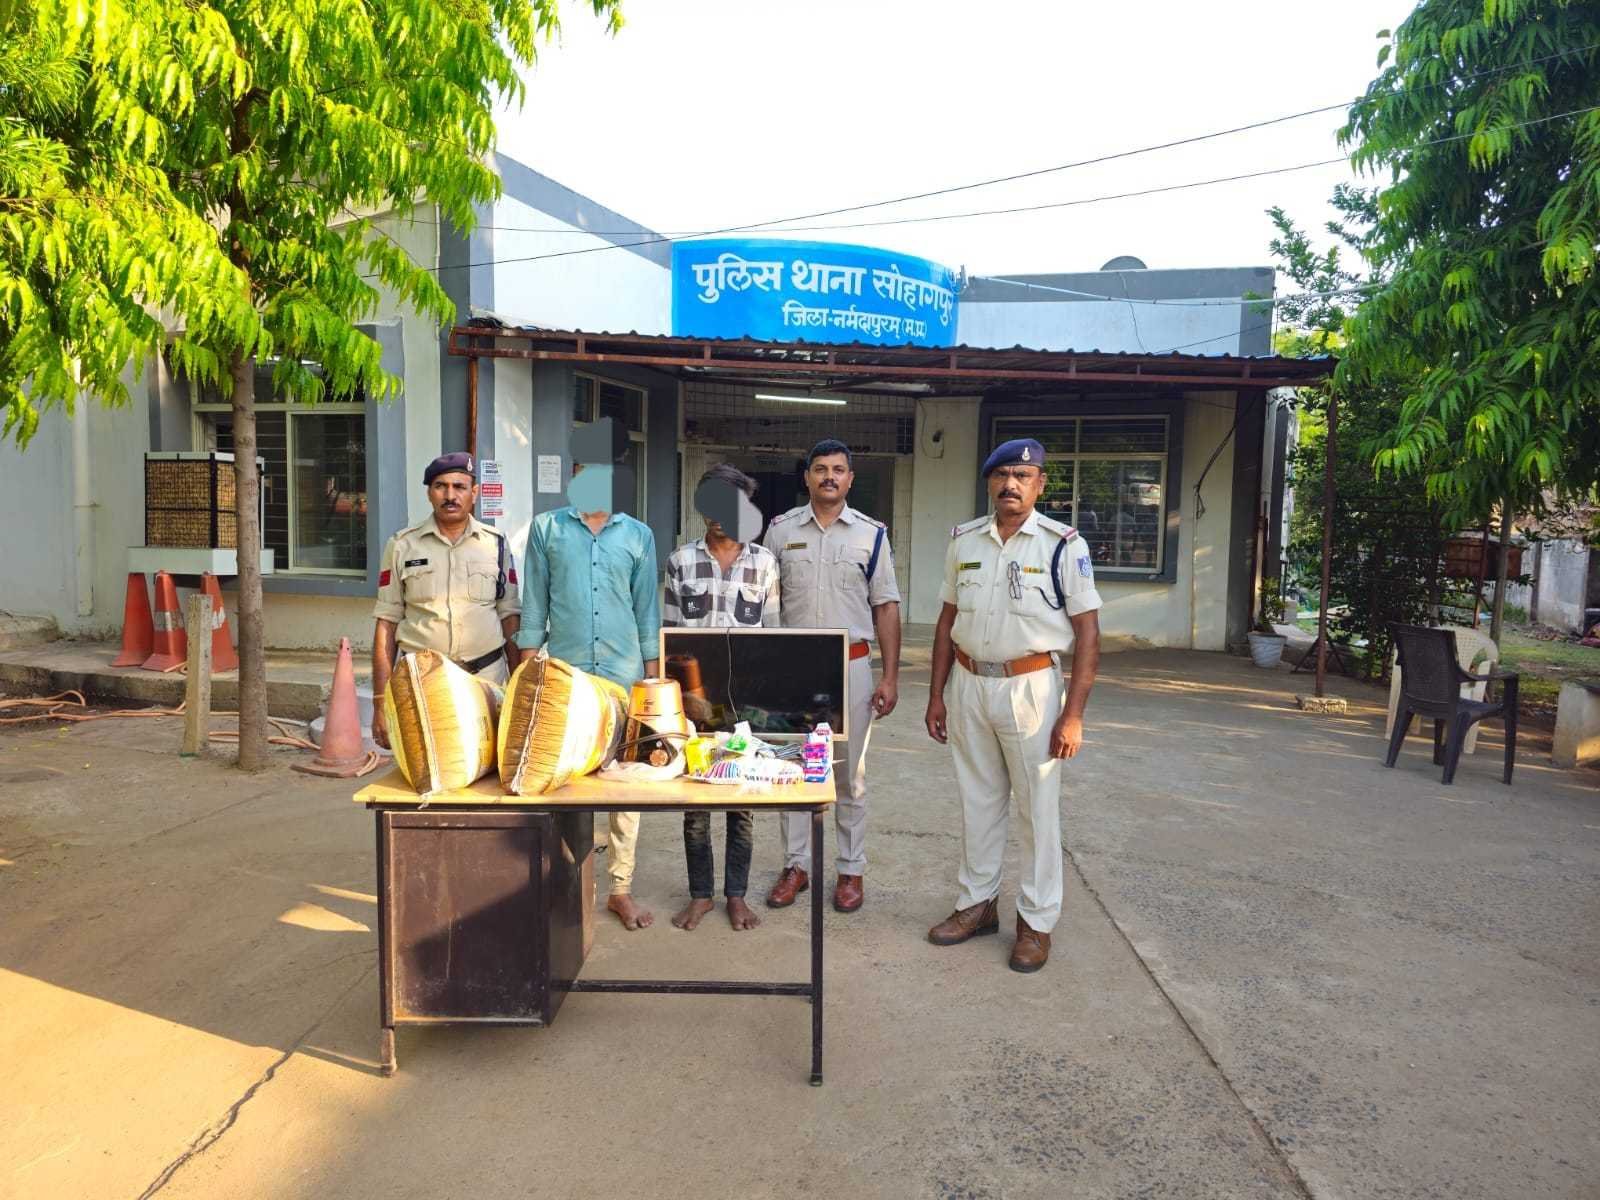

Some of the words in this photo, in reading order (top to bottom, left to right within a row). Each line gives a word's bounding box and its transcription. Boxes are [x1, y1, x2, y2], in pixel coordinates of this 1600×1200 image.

[692, 253, 783, 302] पुलिस
[791, 260, 866, 296] थाना
[872, 263, 954, 327] सोहागपुर
